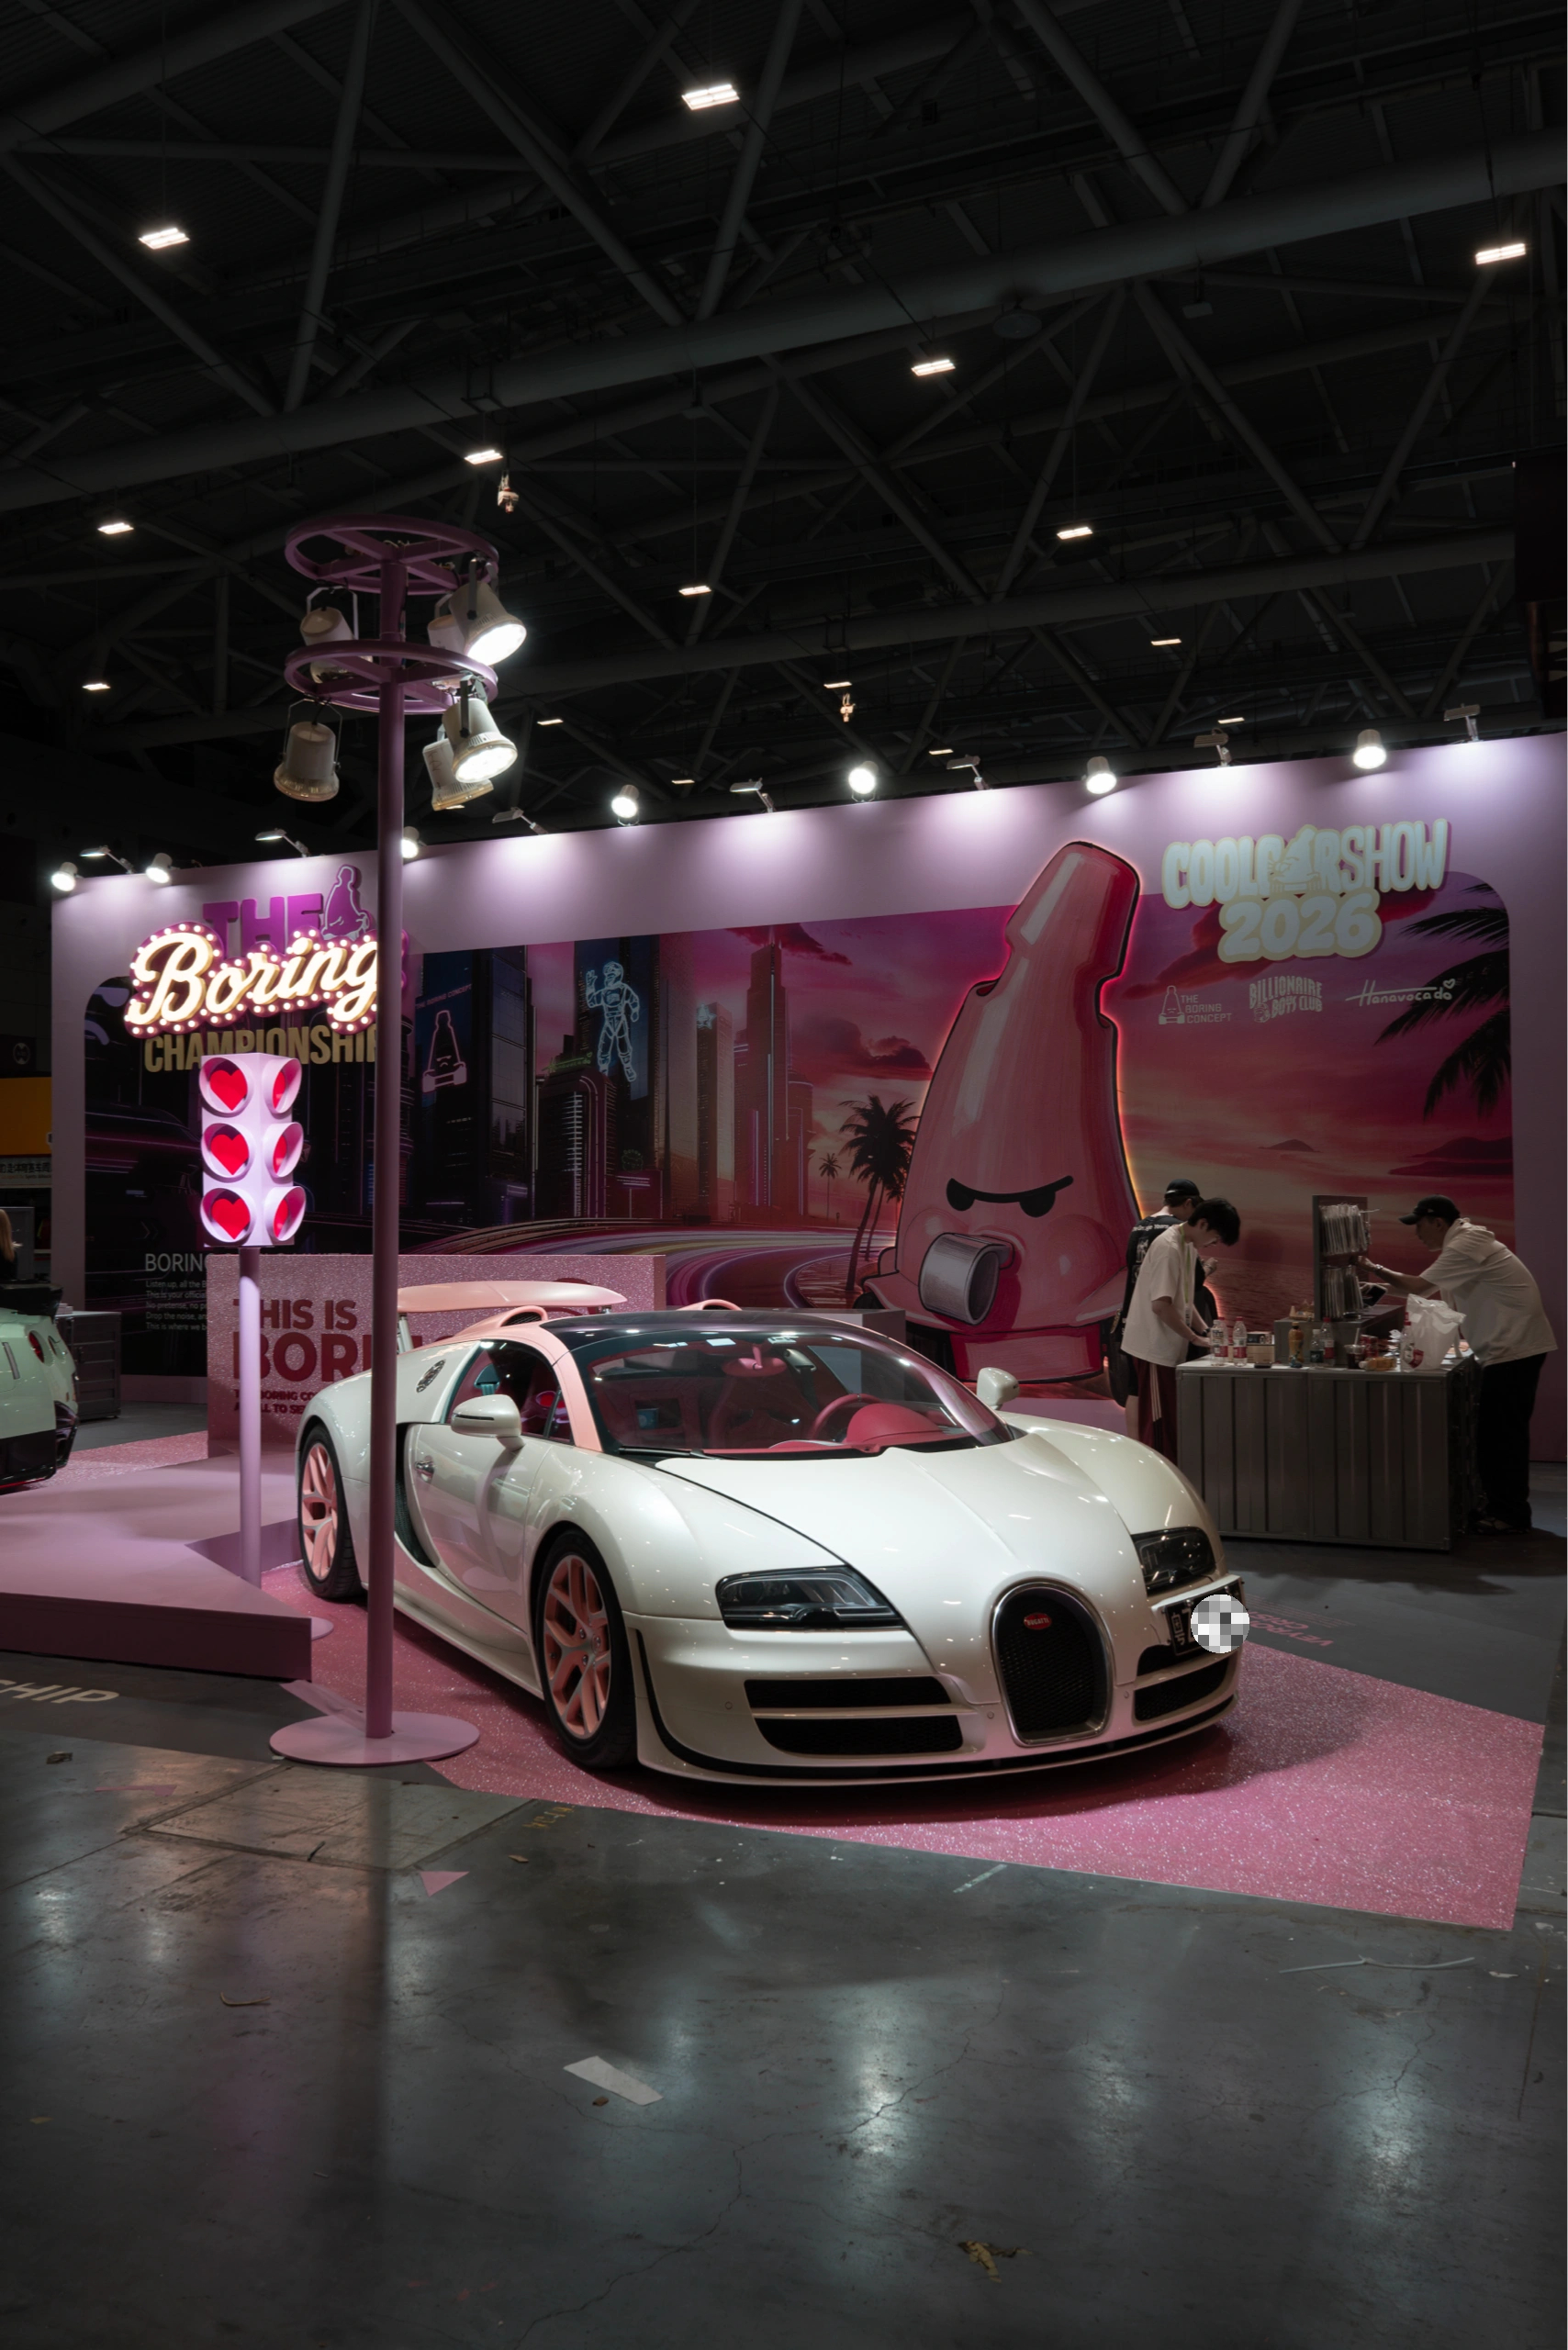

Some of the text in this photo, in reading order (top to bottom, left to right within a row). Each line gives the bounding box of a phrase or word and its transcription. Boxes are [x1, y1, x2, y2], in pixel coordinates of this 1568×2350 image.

[203, 893, 323, 959] THE
[1219, 889, 1380, 960] 2026
[126, 932, 377, 1024] Boring
[1181, 994, 1199, 1003] THE
[1249, 976, 1323, 1009] BILLIONAIRE
[1345, 979, 1452, 1007] Hanavocado
[1185, 1003, 1222, 1013] BORING
[1187, 1013, 1232, 1024] CONCEPT
[1271, 995, 1323, 1019] BOYS CLUB
[145, 1253, 207, 1272] BORIN
[184, 1290, 207, 1298] officia
[325, 1299, 357, 1331] IS
[0, 1679, 119, 1704] HIP
